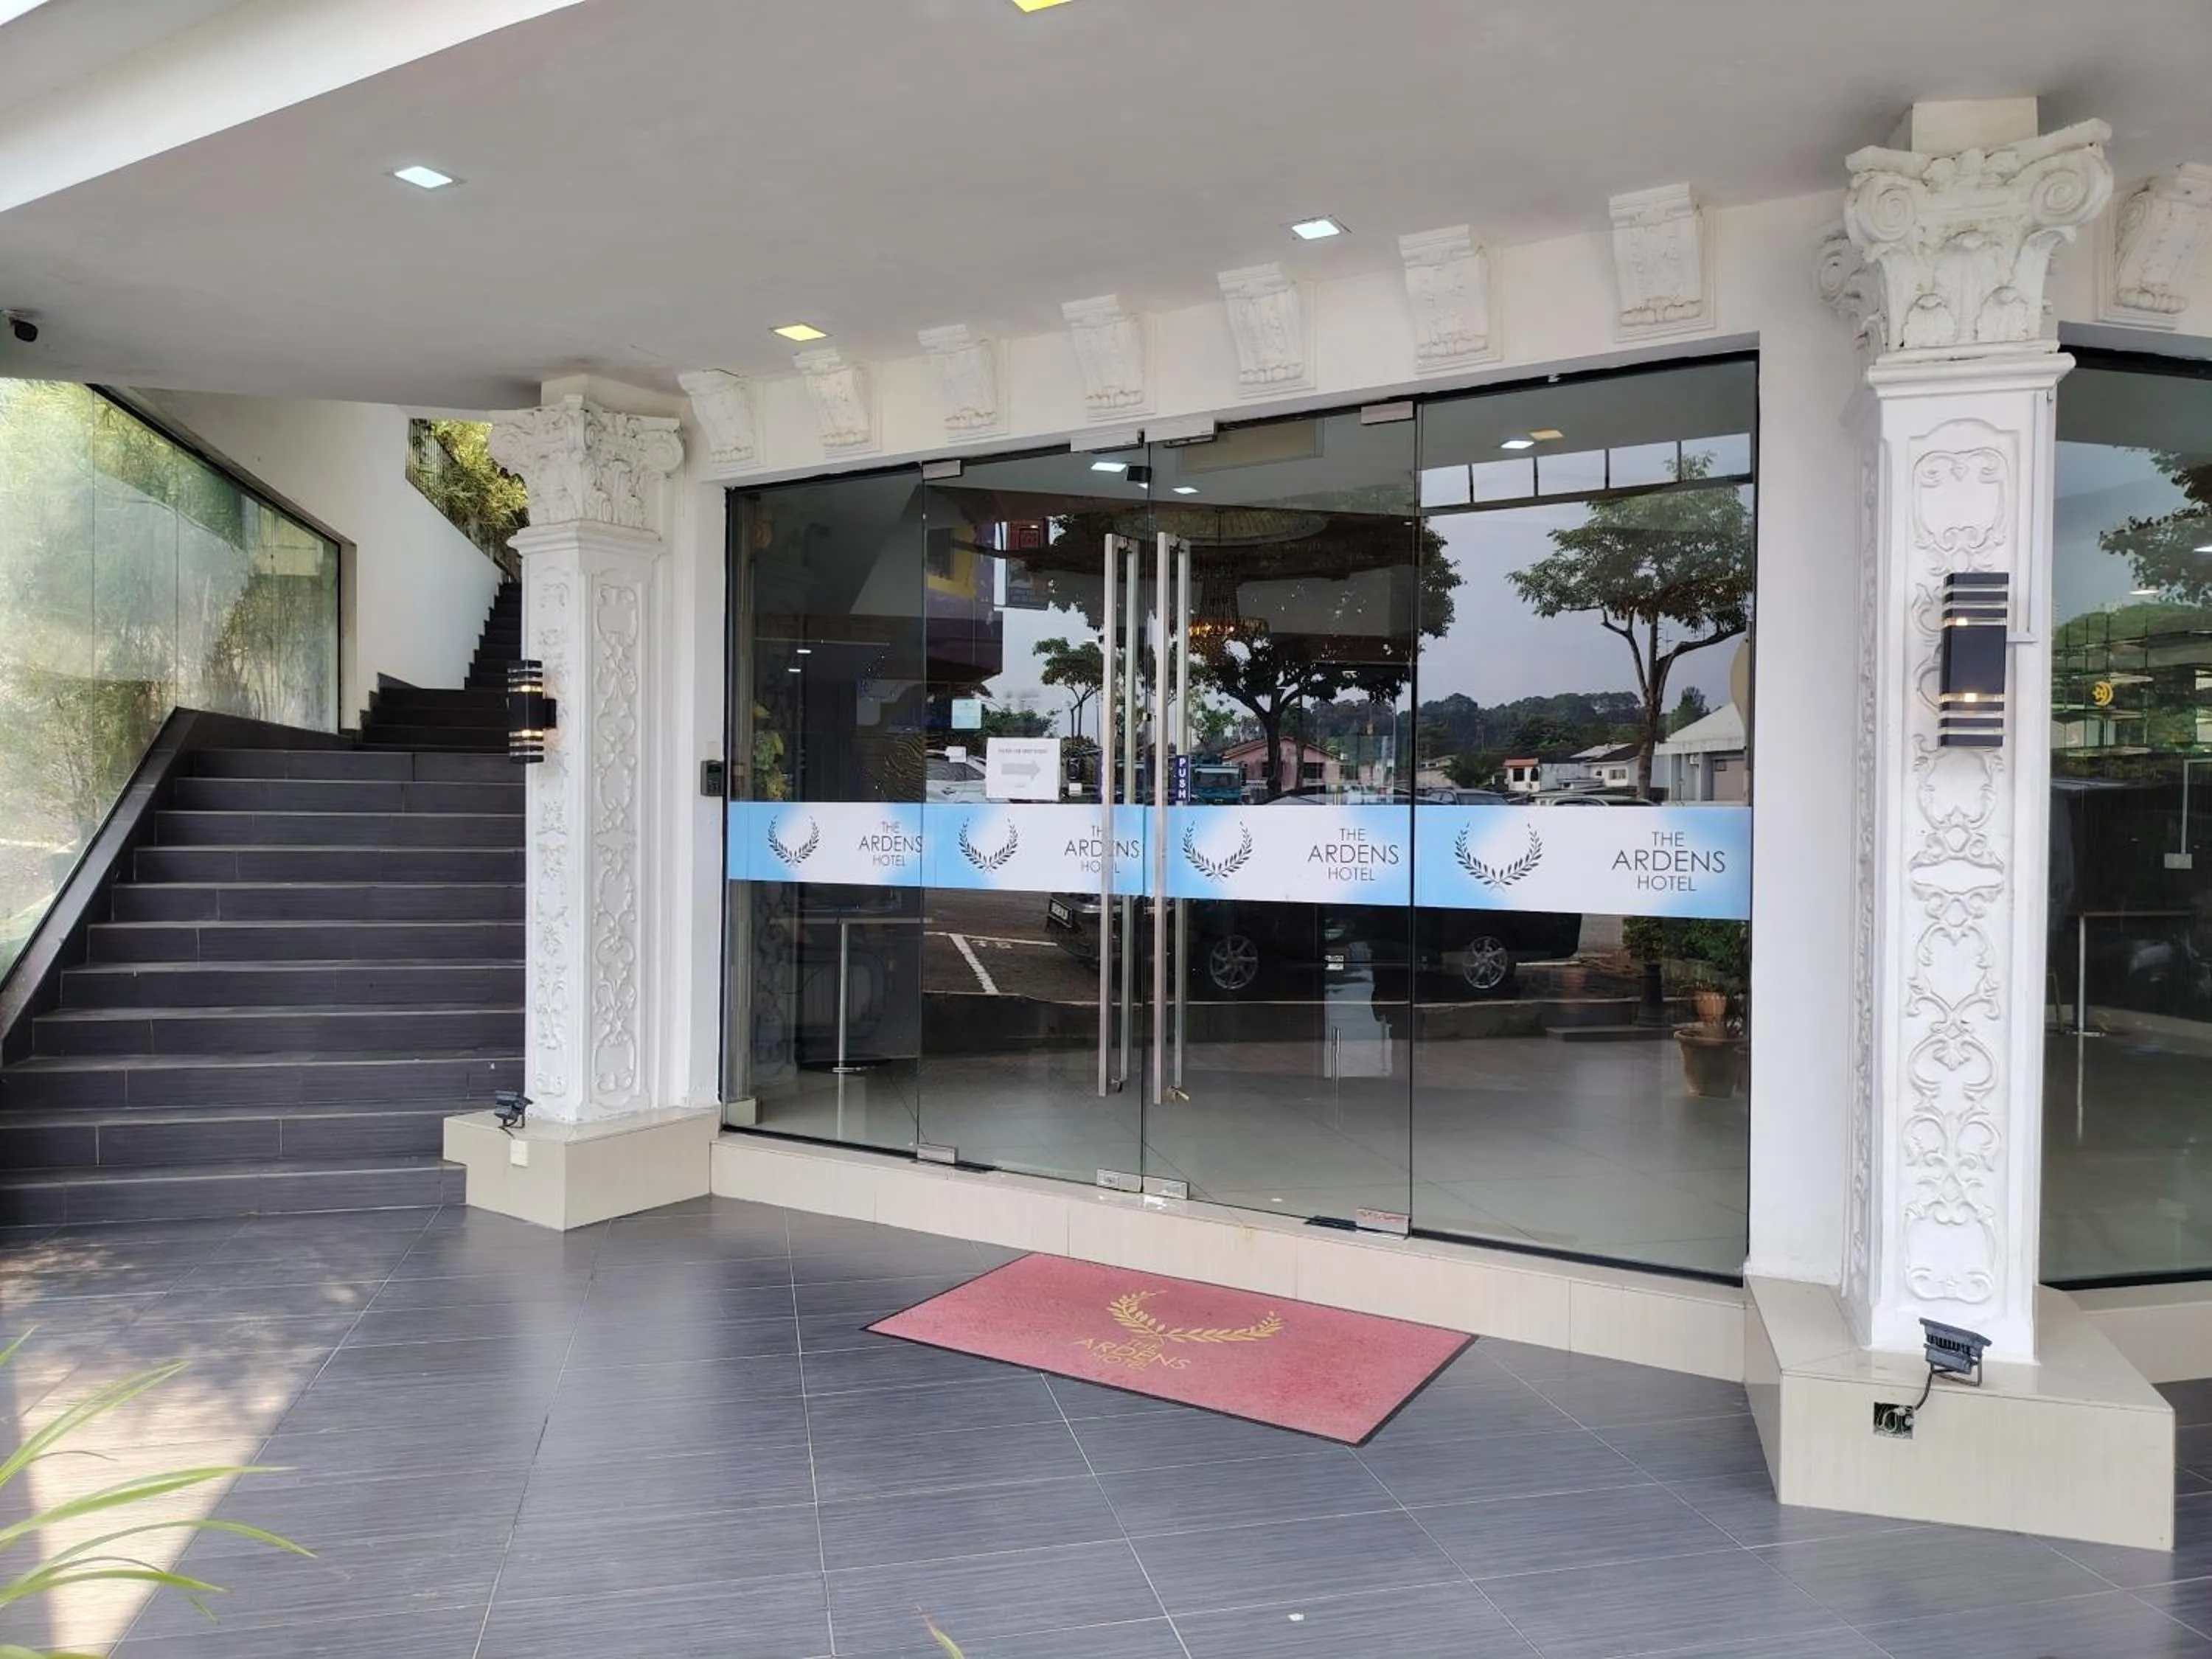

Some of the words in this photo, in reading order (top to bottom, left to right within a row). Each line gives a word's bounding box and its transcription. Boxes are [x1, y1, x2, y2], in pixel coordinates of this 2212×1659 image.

[1178, 757, 1186, 799] PUSH
[880, 821, 901, 833] THE
[1091, 825, 1106, 837] TH
[1339, 828, 1366, 841] THE
[858, 835, 922, 853] ARDENS
[1651, 831, 1685, 847] THE
[1064, 839, 1140, 858] ARDNS
[1307, 844, 1399, 865] ARDENS
[872, 855, 905, 866] HOTEL
[1080, 860, 1121, 874] HOL
[1611, 849, 1726, 874] ARDENS
[1328, 866, 1376, 881] HOTEL
[1637, 874, 1697, 891] HOTEL
[1071, 1338, 1192, 1370] ARDENS
